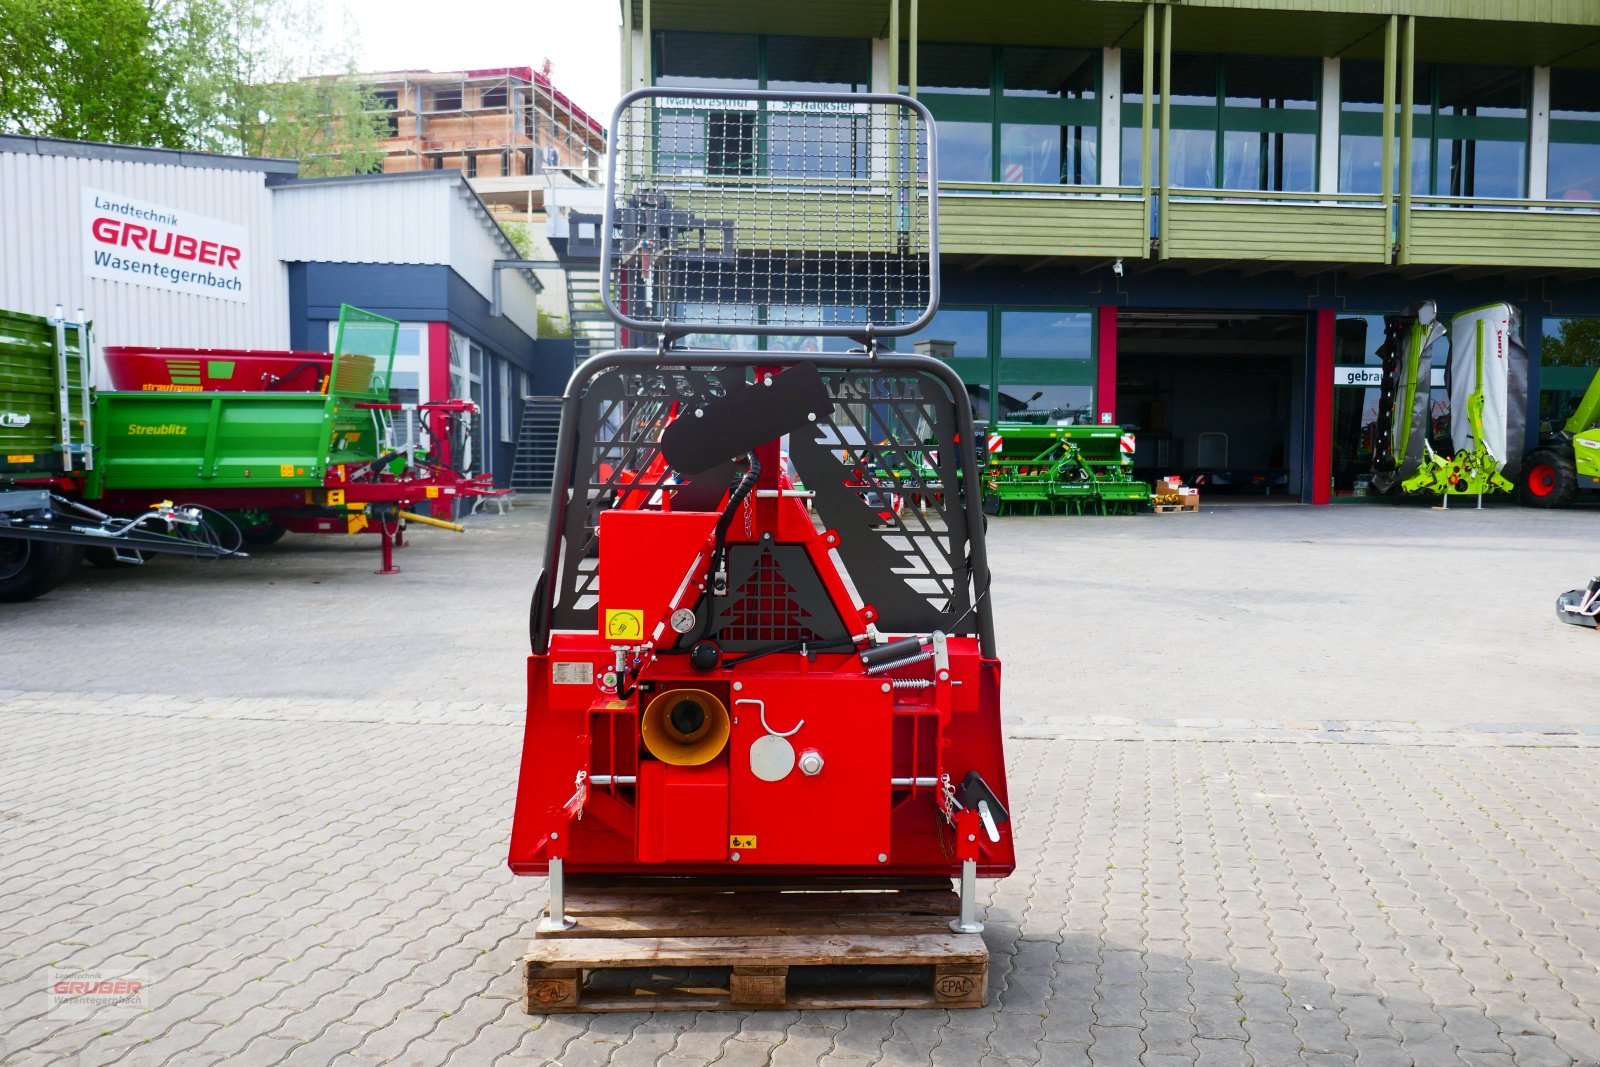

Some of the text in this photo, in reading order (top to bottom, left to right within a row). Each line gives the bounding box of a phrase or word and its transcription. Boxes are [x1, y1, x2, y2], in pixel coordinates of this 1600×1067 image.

[94, 196, 179, 226] Landtechnik
[92, 217, 241, 270] GRUBER
[94, 250, 242, 292] Wasentegernbach
[128, 424, 188, 435] Streublitz
[941, 980, 968, 993] EPAL
